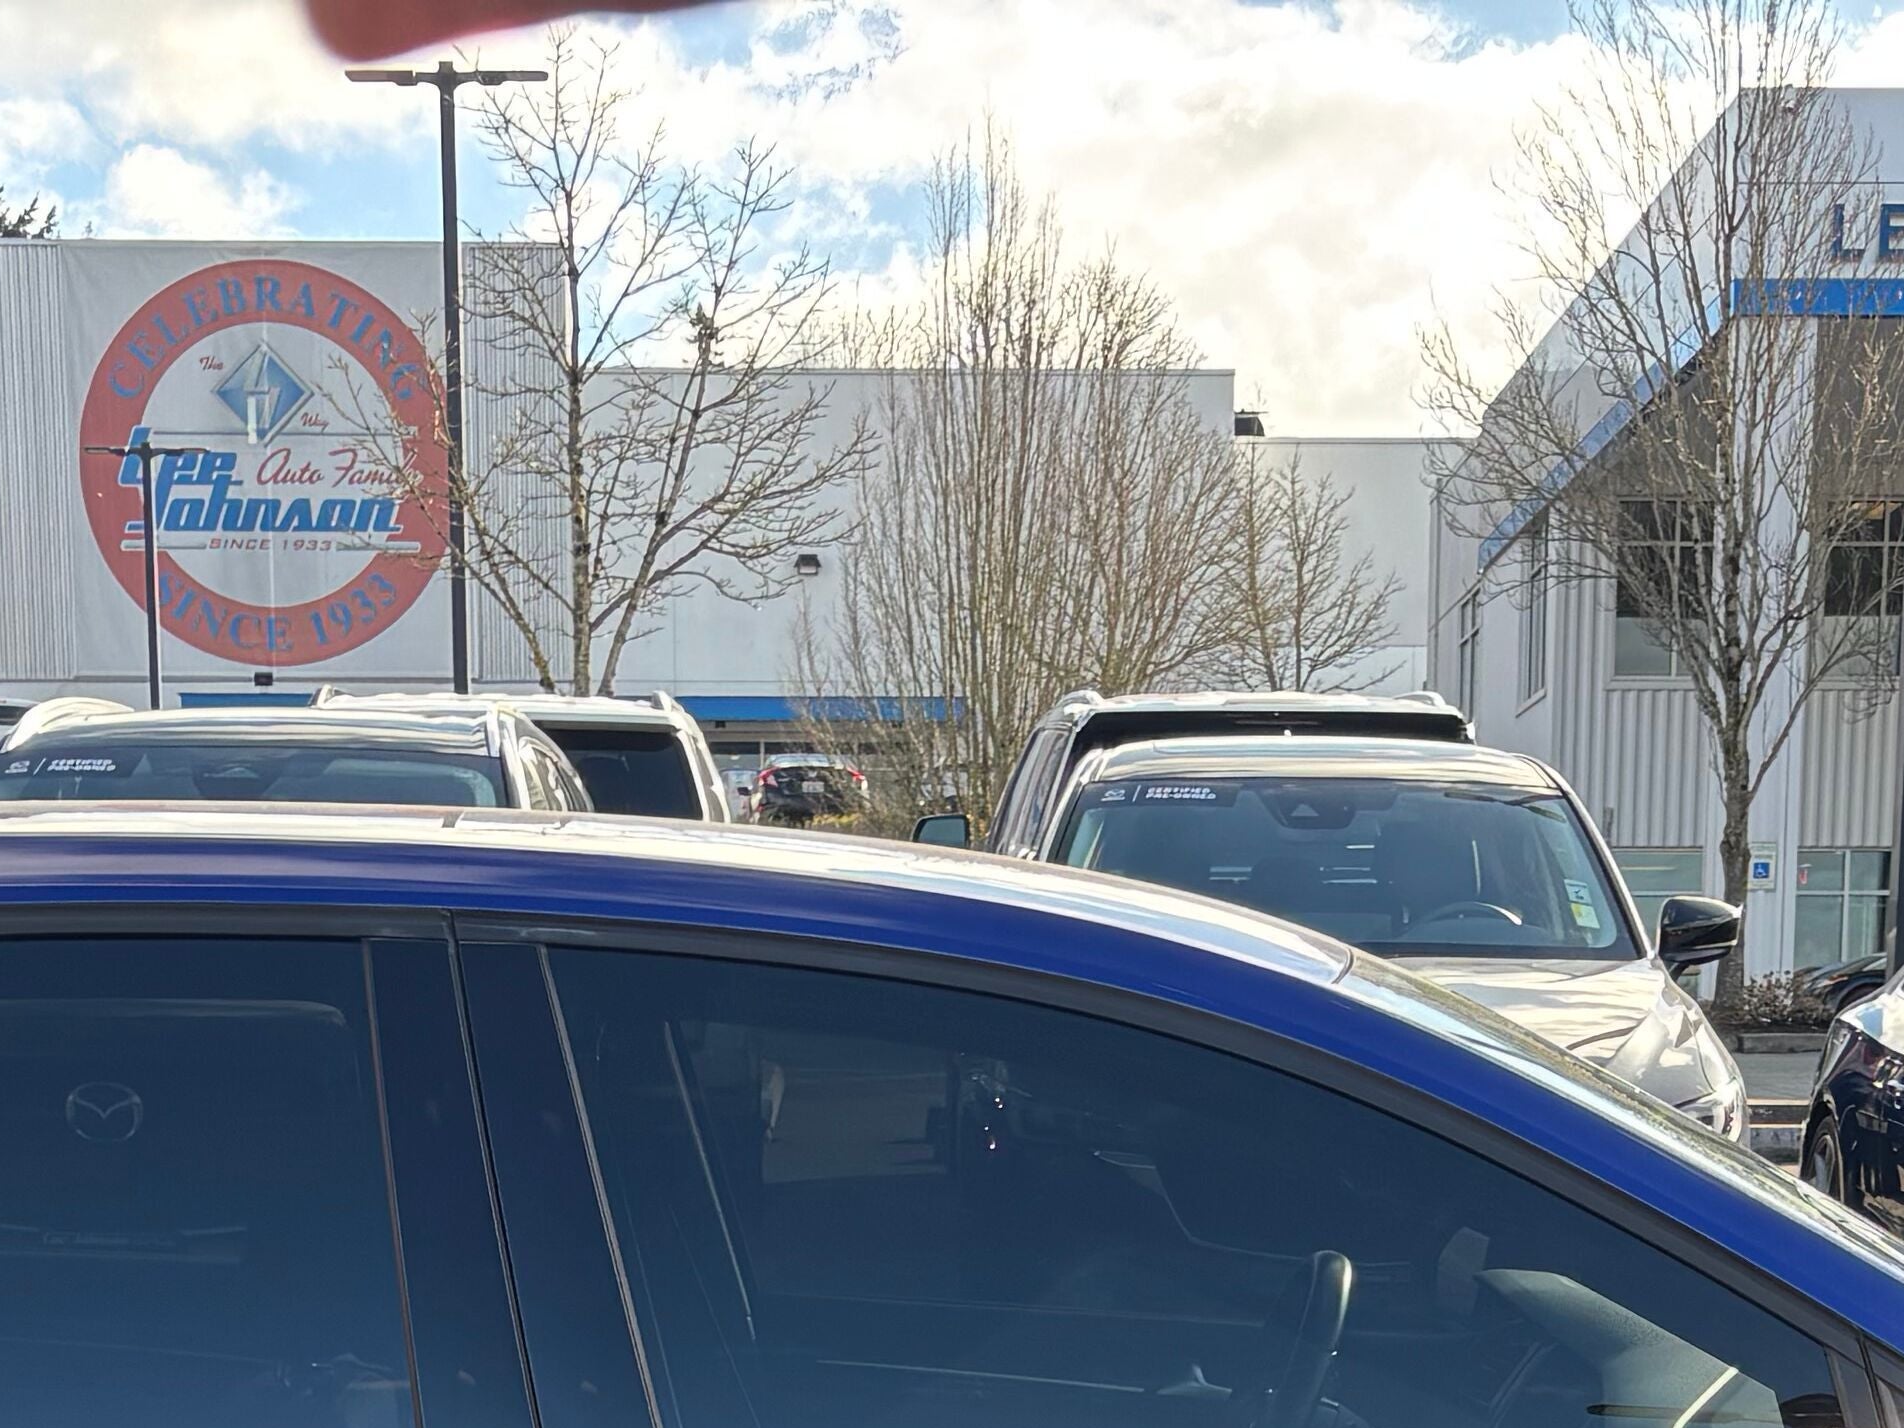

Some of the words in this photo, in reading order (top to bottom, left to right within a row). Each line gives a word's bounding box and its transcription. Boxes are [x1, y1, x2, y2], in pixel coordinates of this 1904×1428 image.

[107, 274, 428, 400] CELEBRATING
[119, 427, 243, 486] Lee
[256, 447, 325, 486] Auto
[125, 478, 403, 532] Johnson
[208, 538, 271, 551] SINCE
[281, 538, 332, 552] 1933
[159, 571, 294, 652] SINCE
[310, 571, 396, 646] 1933
